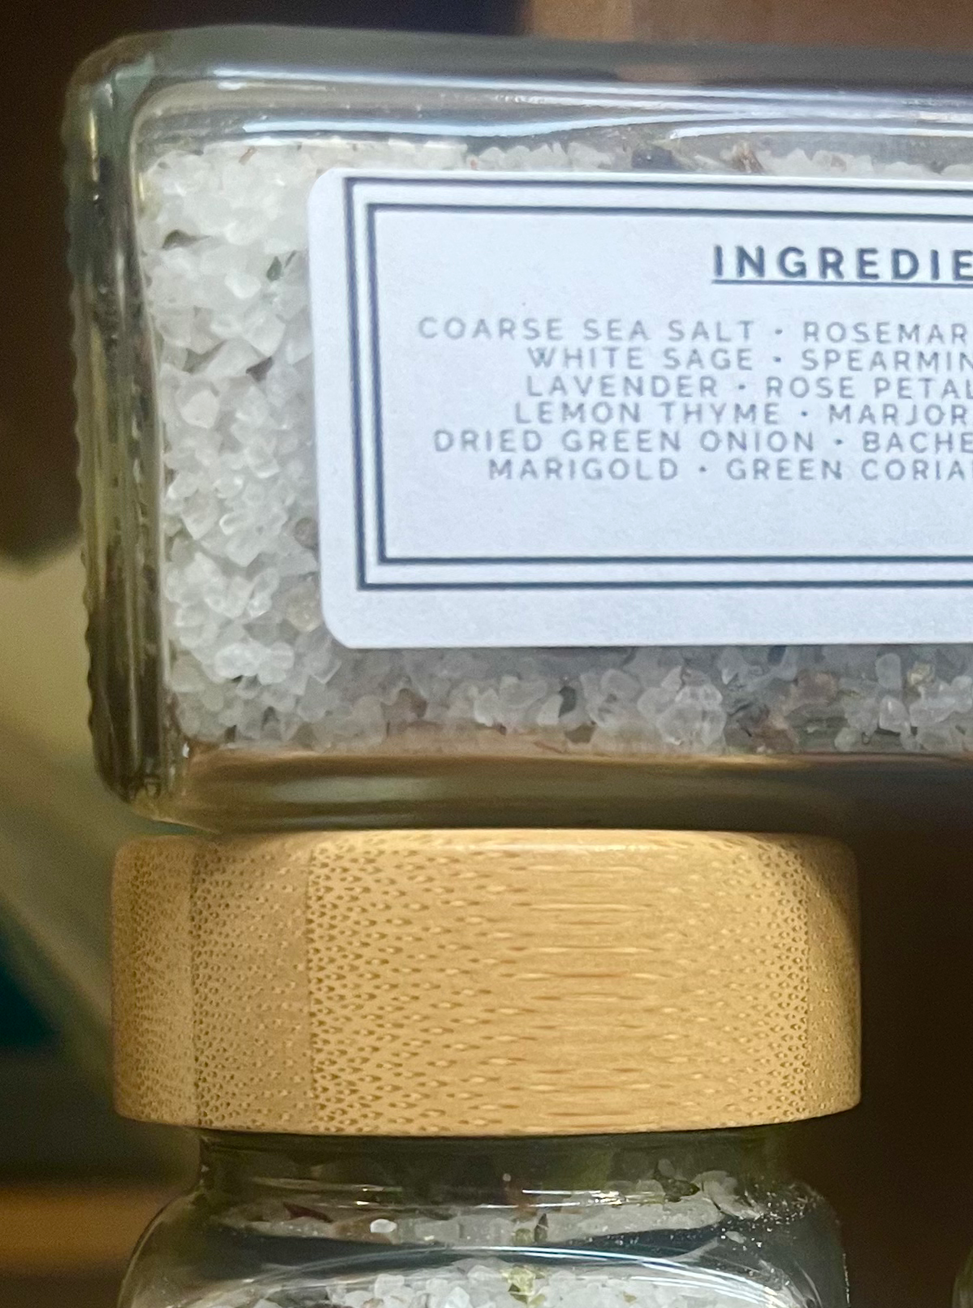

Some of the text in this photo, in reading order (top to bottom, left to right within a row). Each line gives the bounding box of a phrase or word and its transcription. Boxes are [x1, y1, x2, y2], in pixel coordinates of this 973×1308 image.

[417, 317, 563, 341] COARSE
[583, 318, 650, 341] SEA
[668, 320, 754, 342] SALT
[527, 347, 645, 369] WHITE
[662, 348, 753, 371] SAGE
[526, 375, 718, 397] LAVENDER
[766, 377, 855, 399] ROSE
[514, 402, 640, 424] LEMON
[659, 403, 780, 425] THYME
[434, 430, 542, 452] DRIED
[562, 431, 681, 453] GREEN
[700, 431, 815, 452] ONION
[488, 458, 679, 481] MARIGOLD
[726, 459, 843, 481] GREEN
